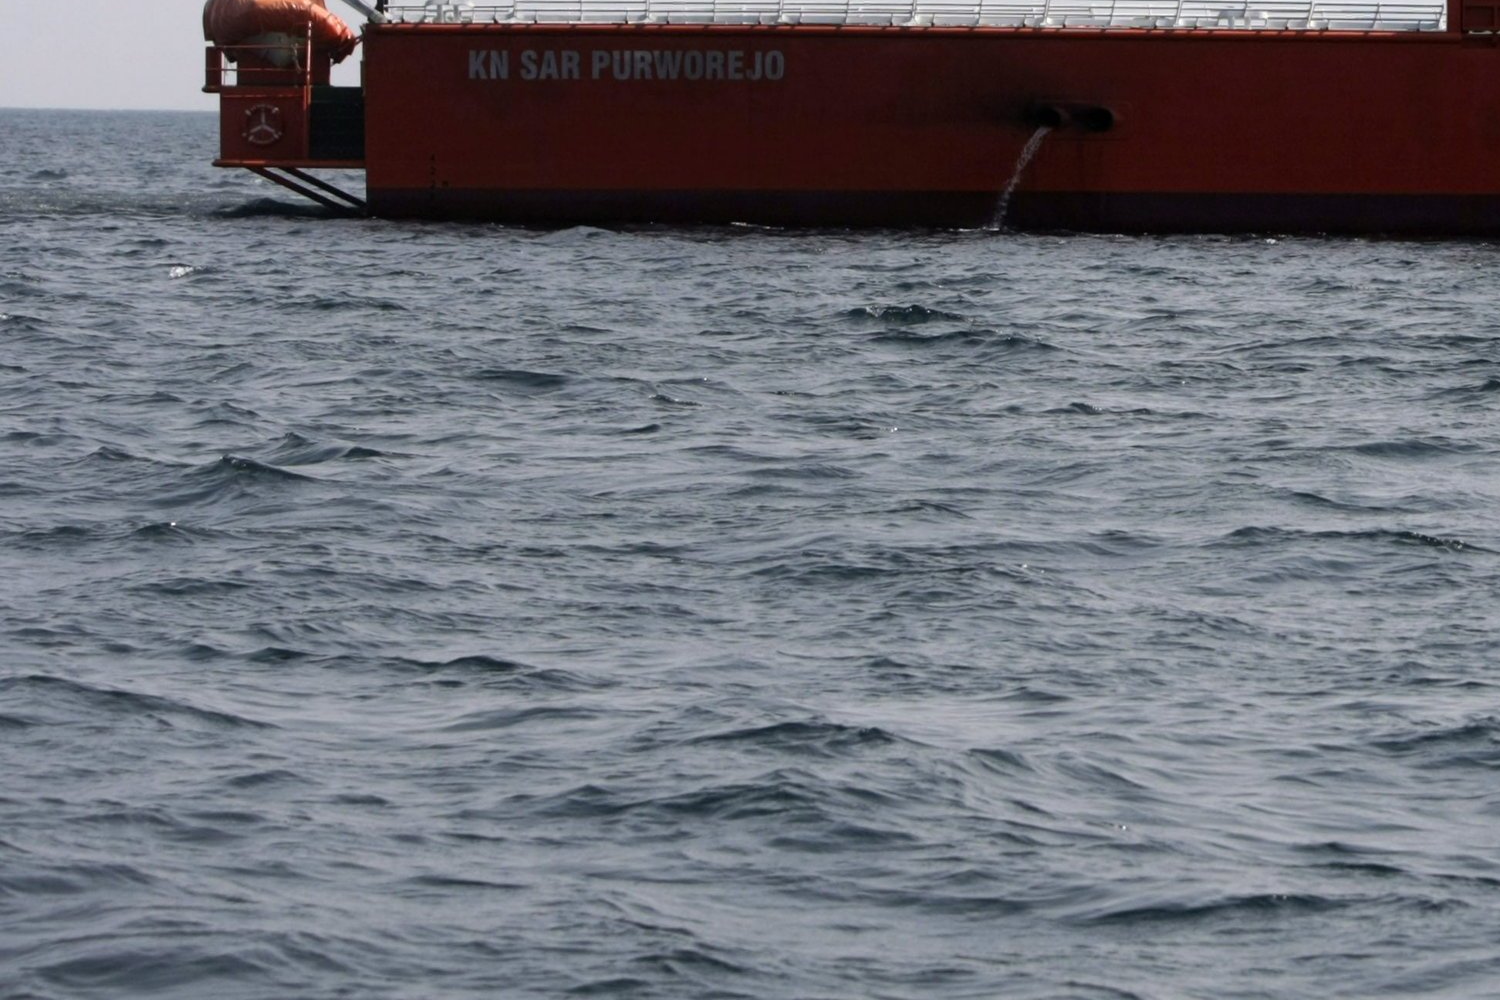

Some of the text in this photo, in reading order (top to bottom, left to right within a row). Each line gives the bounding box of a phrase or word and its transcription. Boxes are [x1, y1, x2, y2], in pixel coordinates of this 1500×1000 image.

[468, 50, 785, 80] KN SAR PURWOREJO
